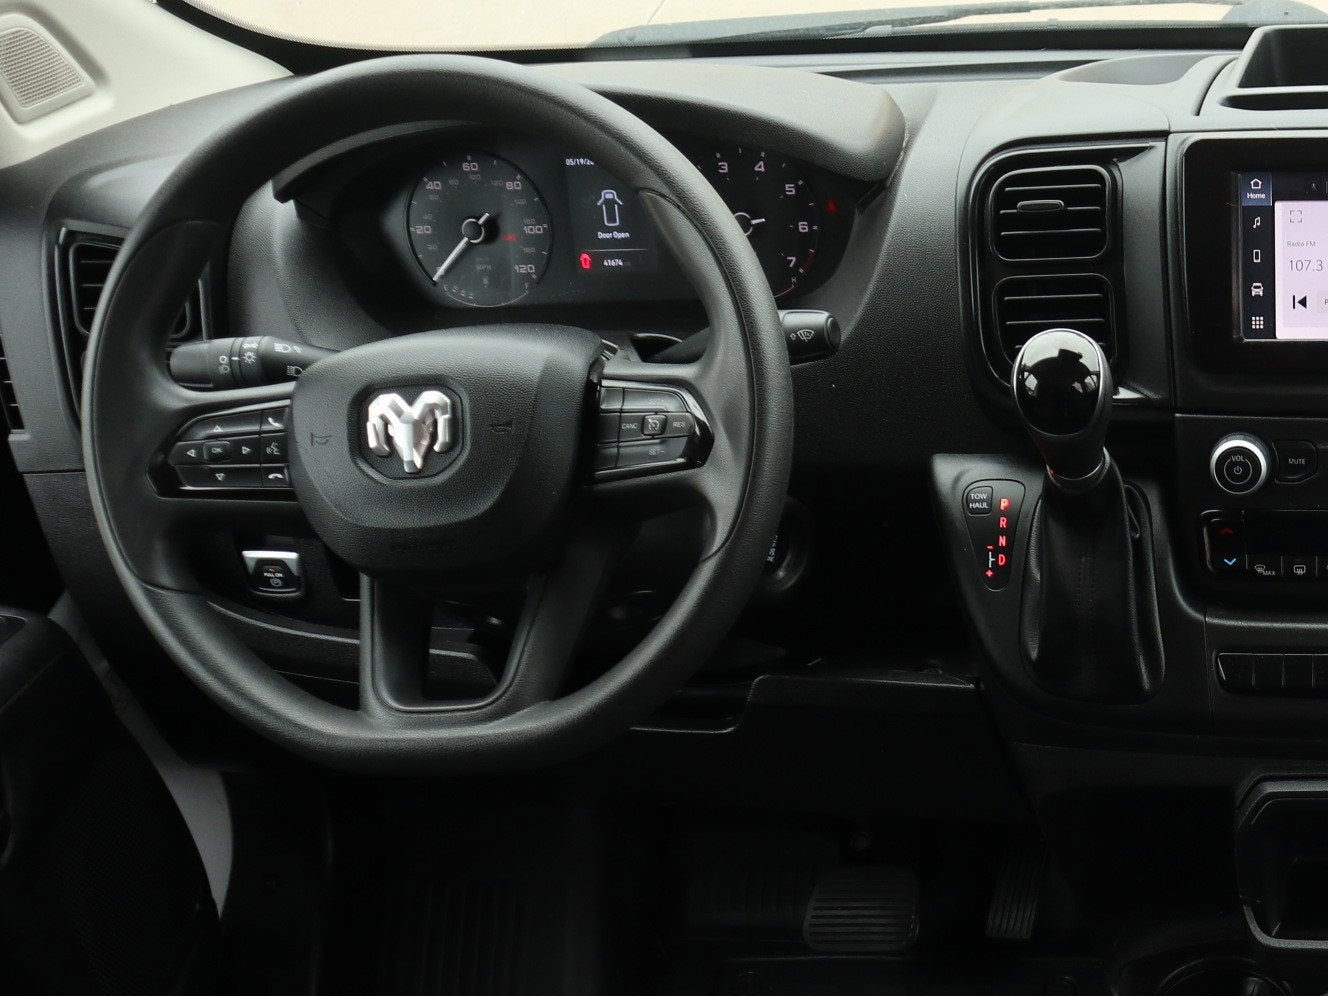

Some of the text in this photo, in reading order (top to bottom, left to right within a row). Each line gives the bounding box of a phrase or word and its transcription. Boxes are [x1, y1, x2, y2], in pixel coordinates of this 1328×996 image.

[462, 162, 479, 171] 60
[718, 162, 729, 173] 3
[754, 161, 765, 173] 4
[425, 181, 442, 190] 40
[505, 181, 522, 190] 80
[785, 184, 796, 195] 5
[416, 225, 432, 234] 20
[523, 225, 543, 234] 100
[798, 222, 809, 232] 6
[597, 231, 630, 240] Door Open
[1286, 240, 1305, 248] Radio
[787, 257, 796, 267] 7
[1289, 259, 1324, 272] 107.3
[514, 264, 536, 273] 120
[1000, 498, 1010, 510] P
[999, 517, 1007, 528] R
[998, 536, 1007, 547] N
[998, 554, 1006, 566] D
